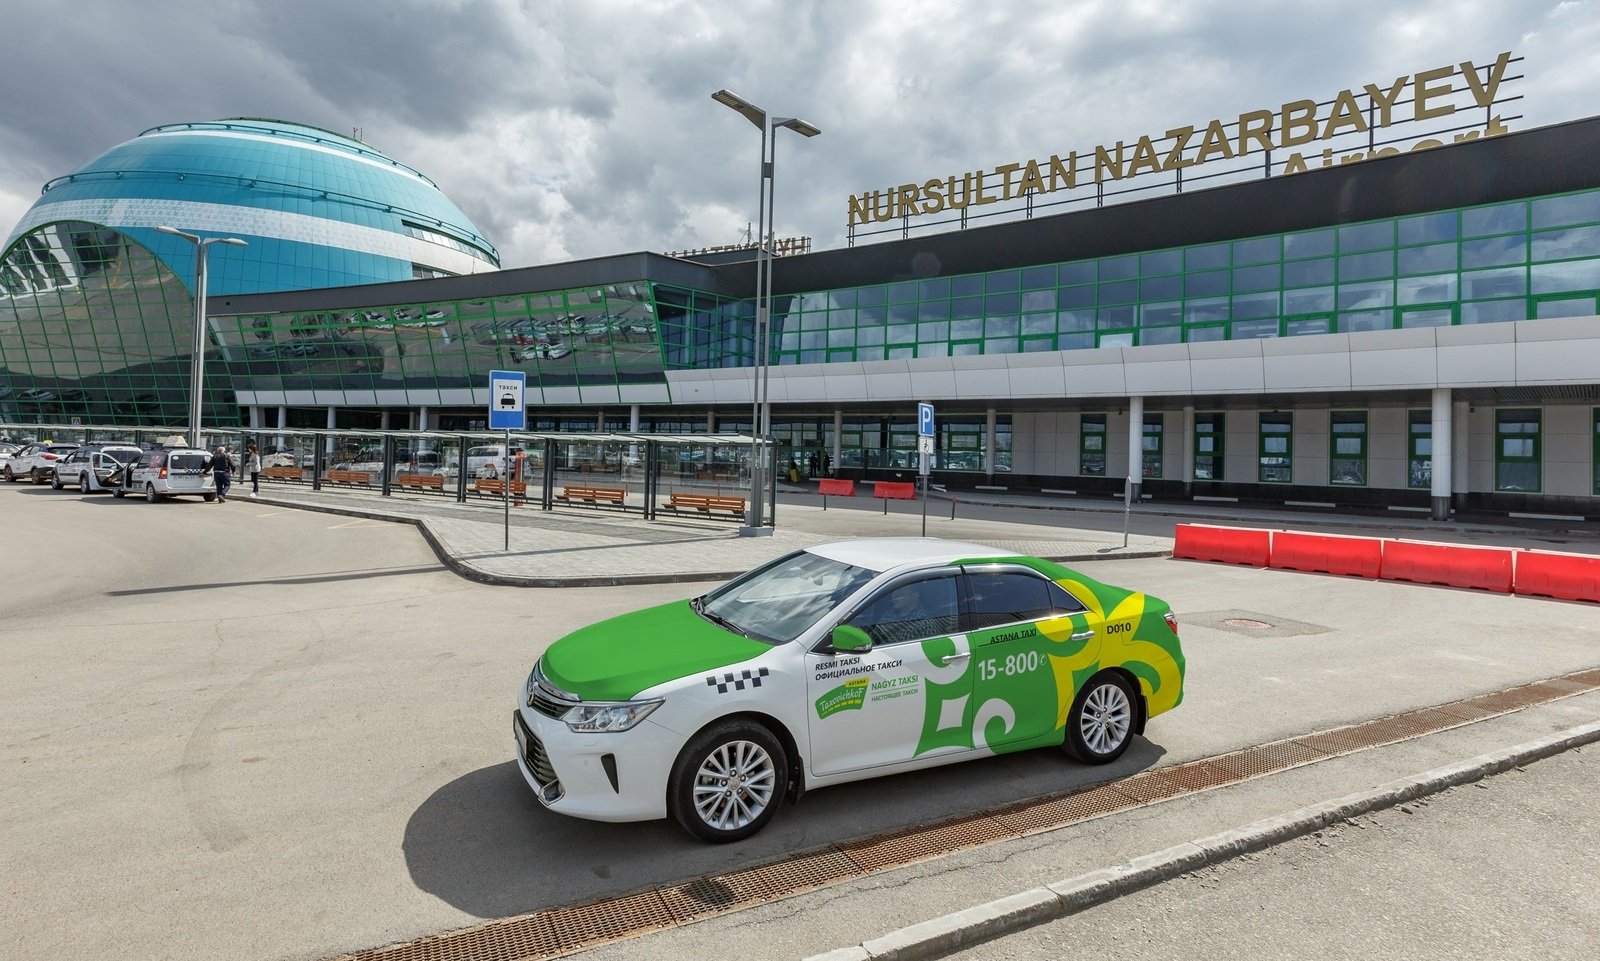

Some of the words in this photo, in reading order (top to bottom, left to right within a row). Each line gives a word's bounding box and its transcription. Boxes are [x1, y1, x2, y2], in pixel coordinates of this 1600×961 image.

[848, 151, 1077, 227] NURSULTAN
[1095, 51, 1512, 185] NAZARBAYEV
[922, 407, 931, 433] P
[990, 631, 1020, 644] ASTANA
[1020, 628, 1037, 638] TAXI
[1107, 623, 1131, 635] D010
[815, 660, 838, 671] RESMI
[840, 657, 860, 666] TAKSI
[815, 664, 875, 680] ОФИЦИАЛЬНОЕ
[877, 660, 902, 670] ТАКСИ
[978, 650, 1038, 681] 15-800
[898, 675, 919, 686] TAKSI
[871, 692, 901, 702] НАСТОЯЩЕЕ
[902, 689, 919, 697] ТАКСИ
